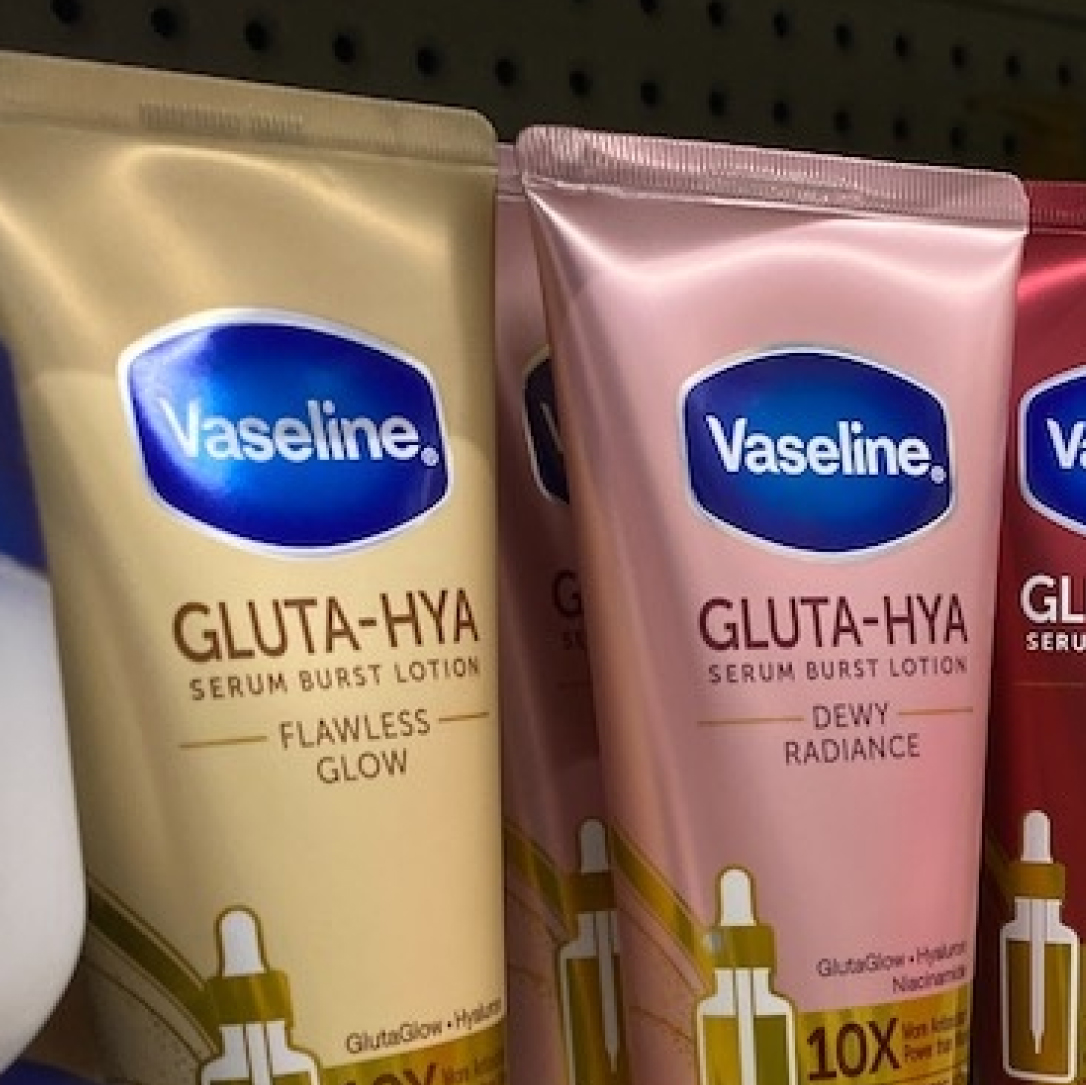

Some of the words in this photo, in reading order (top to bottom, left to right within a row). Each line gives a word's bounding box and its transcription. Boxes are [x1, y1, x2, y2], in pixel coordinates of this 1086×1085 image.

[158, 399, 421, 463] Vaseline
[706, 415, 931, 476] Vaseline
[172, 588, 480, 664] GLUTA-HYA
[699, 595, 968, 651] GLUTA-HYA
[189, 671, 287, 701] SERUM
[300, 664, 383, 692] BURST
[395, 656, 481, 685] LOTION
[708, 661, 794, 684] SERUM
[806, 658, 877, 681] BURST
[889, 656, 967, 678] LOTION
[279, 709, 431, 750] FLAWLESS
[812, 703, 889, 730] DEWY
[317, 749, 408, 784] GLOW
[785, 733, 920, 765] RADIANCE
[816, 952, 906, 977] GlutaGlow
[345, 1019, 443, 1054] GlutaGlow
[807, 1018, 902, 1081] 10X
